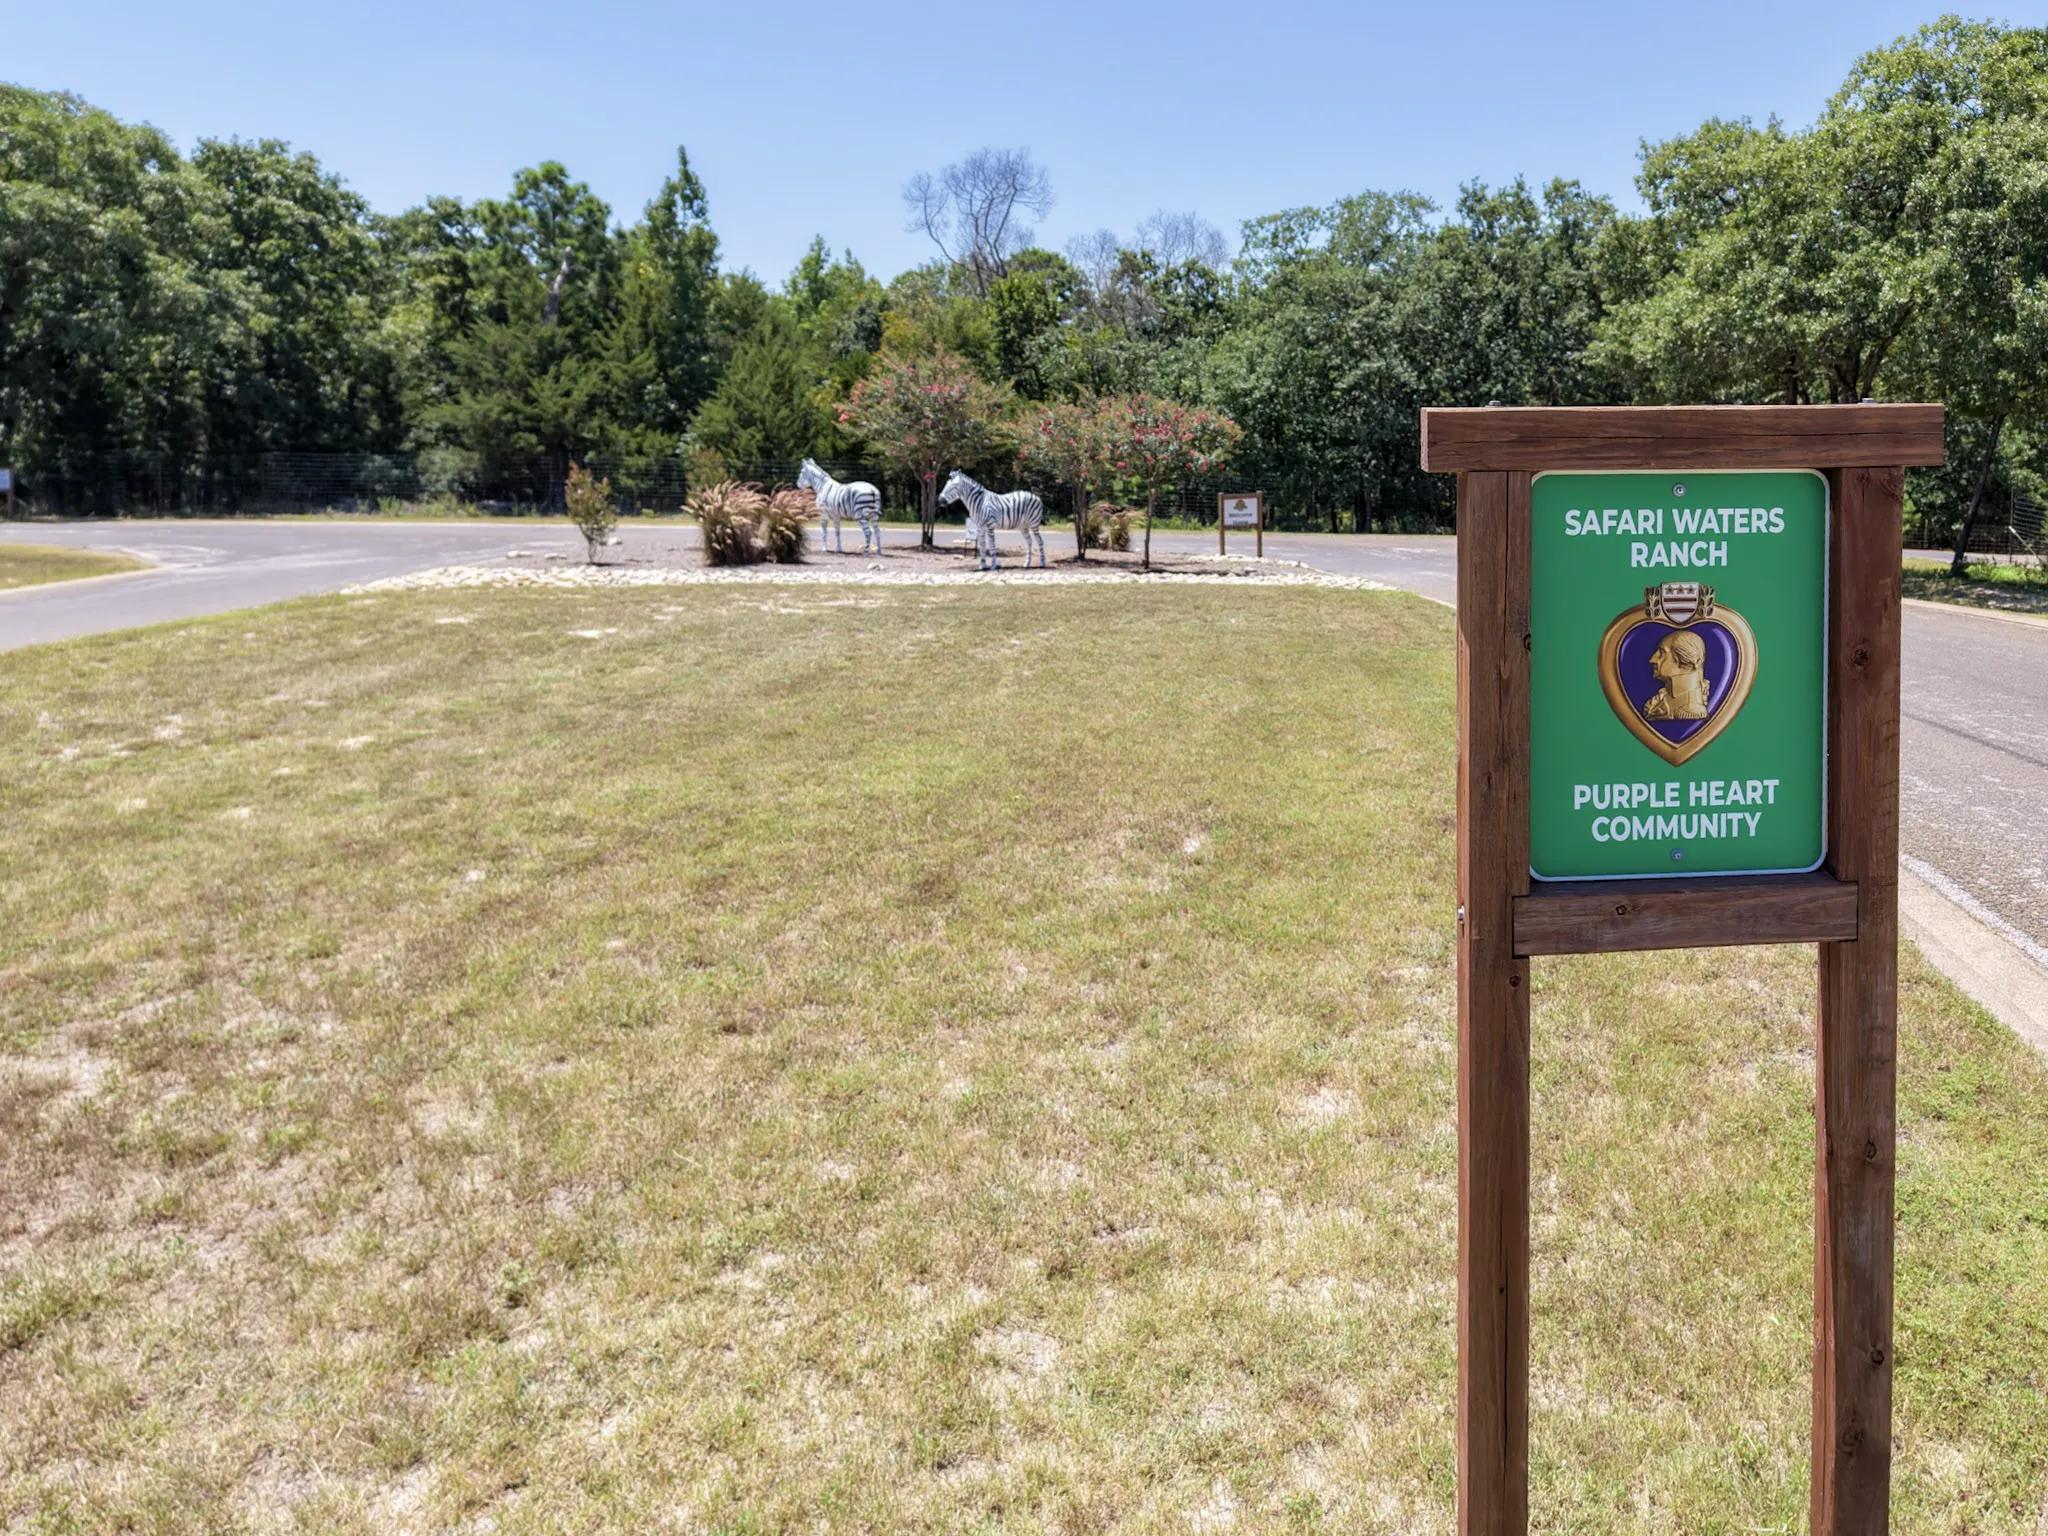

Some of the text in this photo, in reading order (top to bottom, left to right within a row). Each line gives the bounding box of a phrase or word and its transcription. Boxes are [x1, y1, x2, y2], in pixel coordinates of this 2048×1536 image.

[1565, 507, 1785, 536] SAFARI WATERS
[1631, 540, 1728, 568] RANCH
[1574, 779, 1780, 810] PURPLE HEART
[1591, 812, 1762, 842] COMMUNITY
